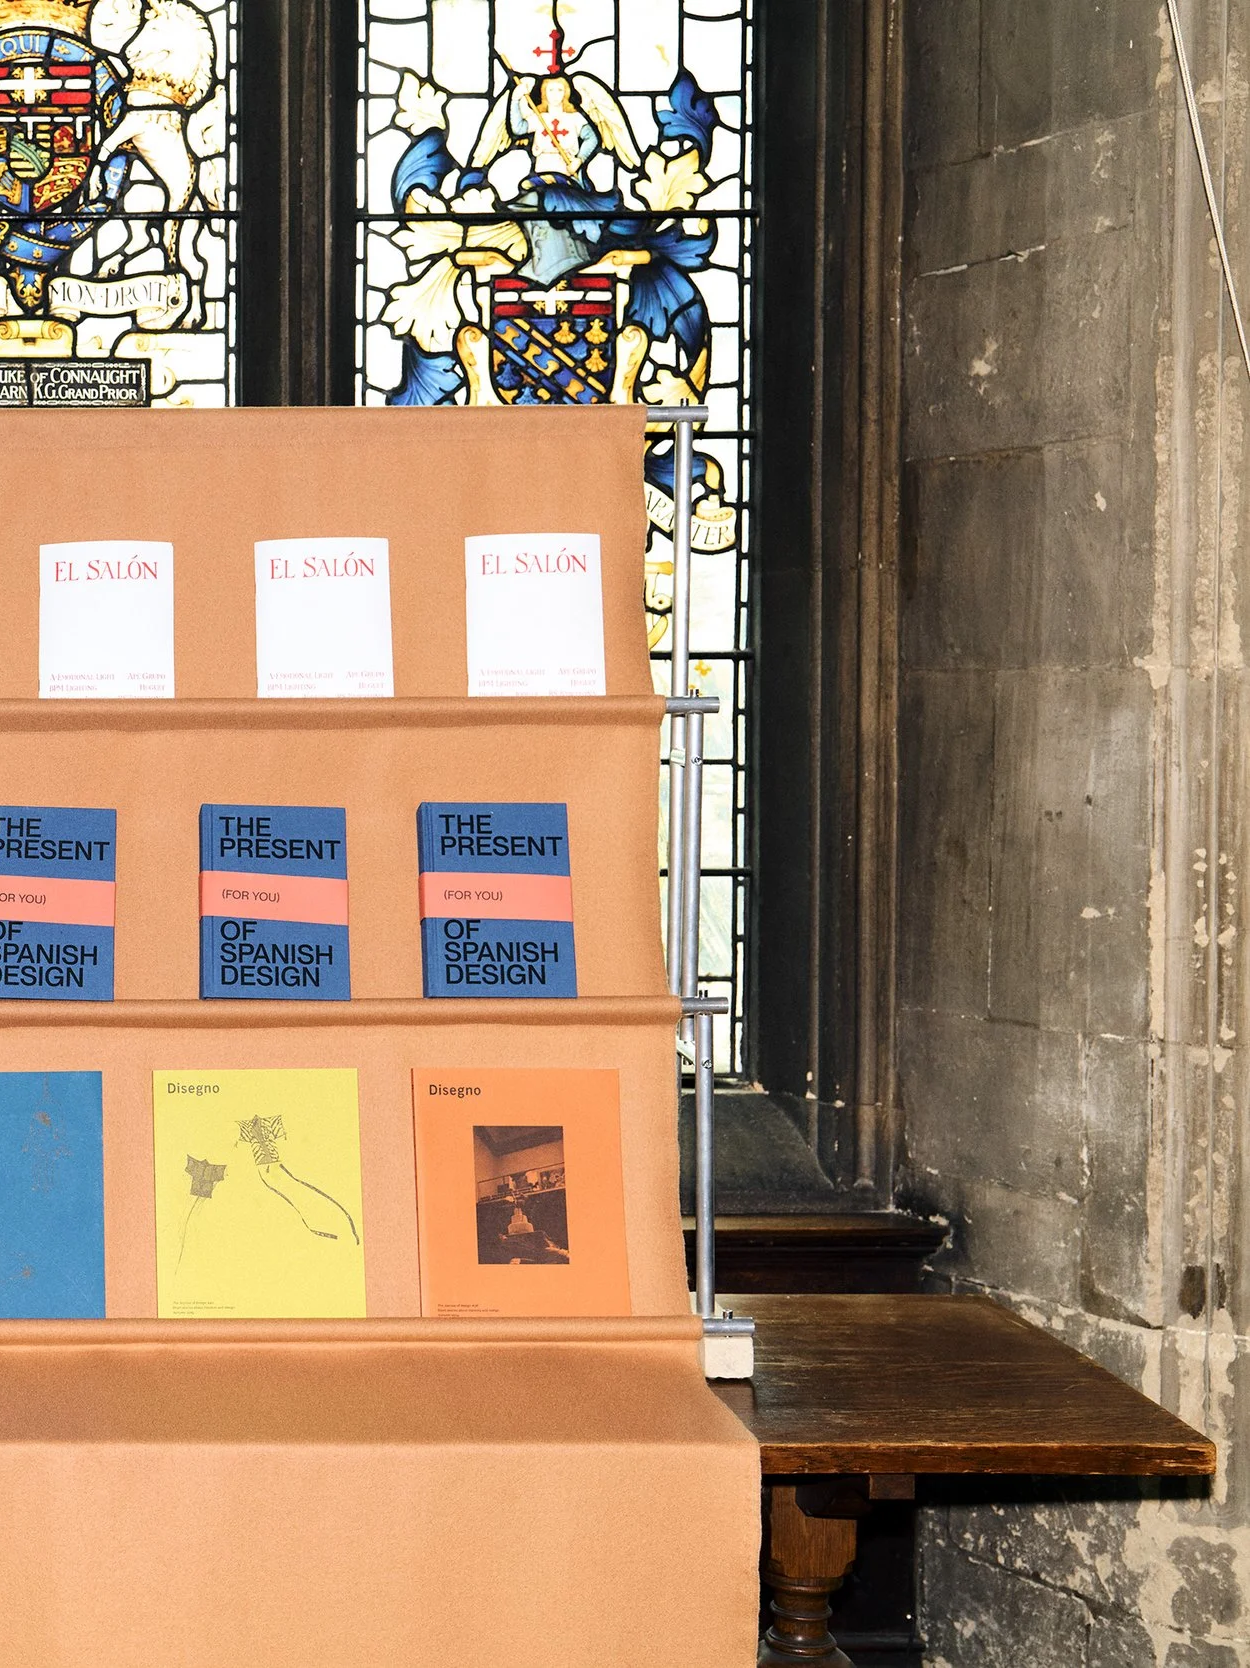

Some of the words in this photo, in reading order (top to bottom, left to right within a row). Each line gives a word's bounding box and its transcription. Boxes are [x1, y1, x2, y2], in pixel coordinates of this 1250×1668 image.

[0, 35, 40, 56] QUI
[51, 368, 140, 383] CONNAUGHT
[59, 386, 98, 399] GRAND
[99, 386, 137, 399] PRIOR
[56, 561, 78, 582] EL
[87, 555, 157, 580] SALÓN
[271, 559, 295, 579] EL
[303, 552, 374, 577] SALÓN
[482, 554, 506, 575] EL
[515, 548, 586, 573] SALÓN
[219, 817, 271, 836] THE
[439, 814, 493, 834] THE
[221, 839, 340, 859] PRESENT
[441, 836, 562, 856] PRESENT
[19, 894, 46, 905] YOU)
[222, 889, 249, 900] (FOR
[253, 892, 279, 903] YOU)
[444, 890, 471, 900] (FOR
[475, 891, 502, 901] YOU)
[220, 920, 258, 941] OF
[443, 919, 481, 940] OF
[220, 941, 332, 966] SPANISH
[445, 942, 558, 962] SPANISH
[221, 964, 319, 987] DESIGN
[446, 964, 545, 984] DESIGN
[168, 1083, 219, 1096] Disegno
[429, 1084, 481, 1098] Disegno
